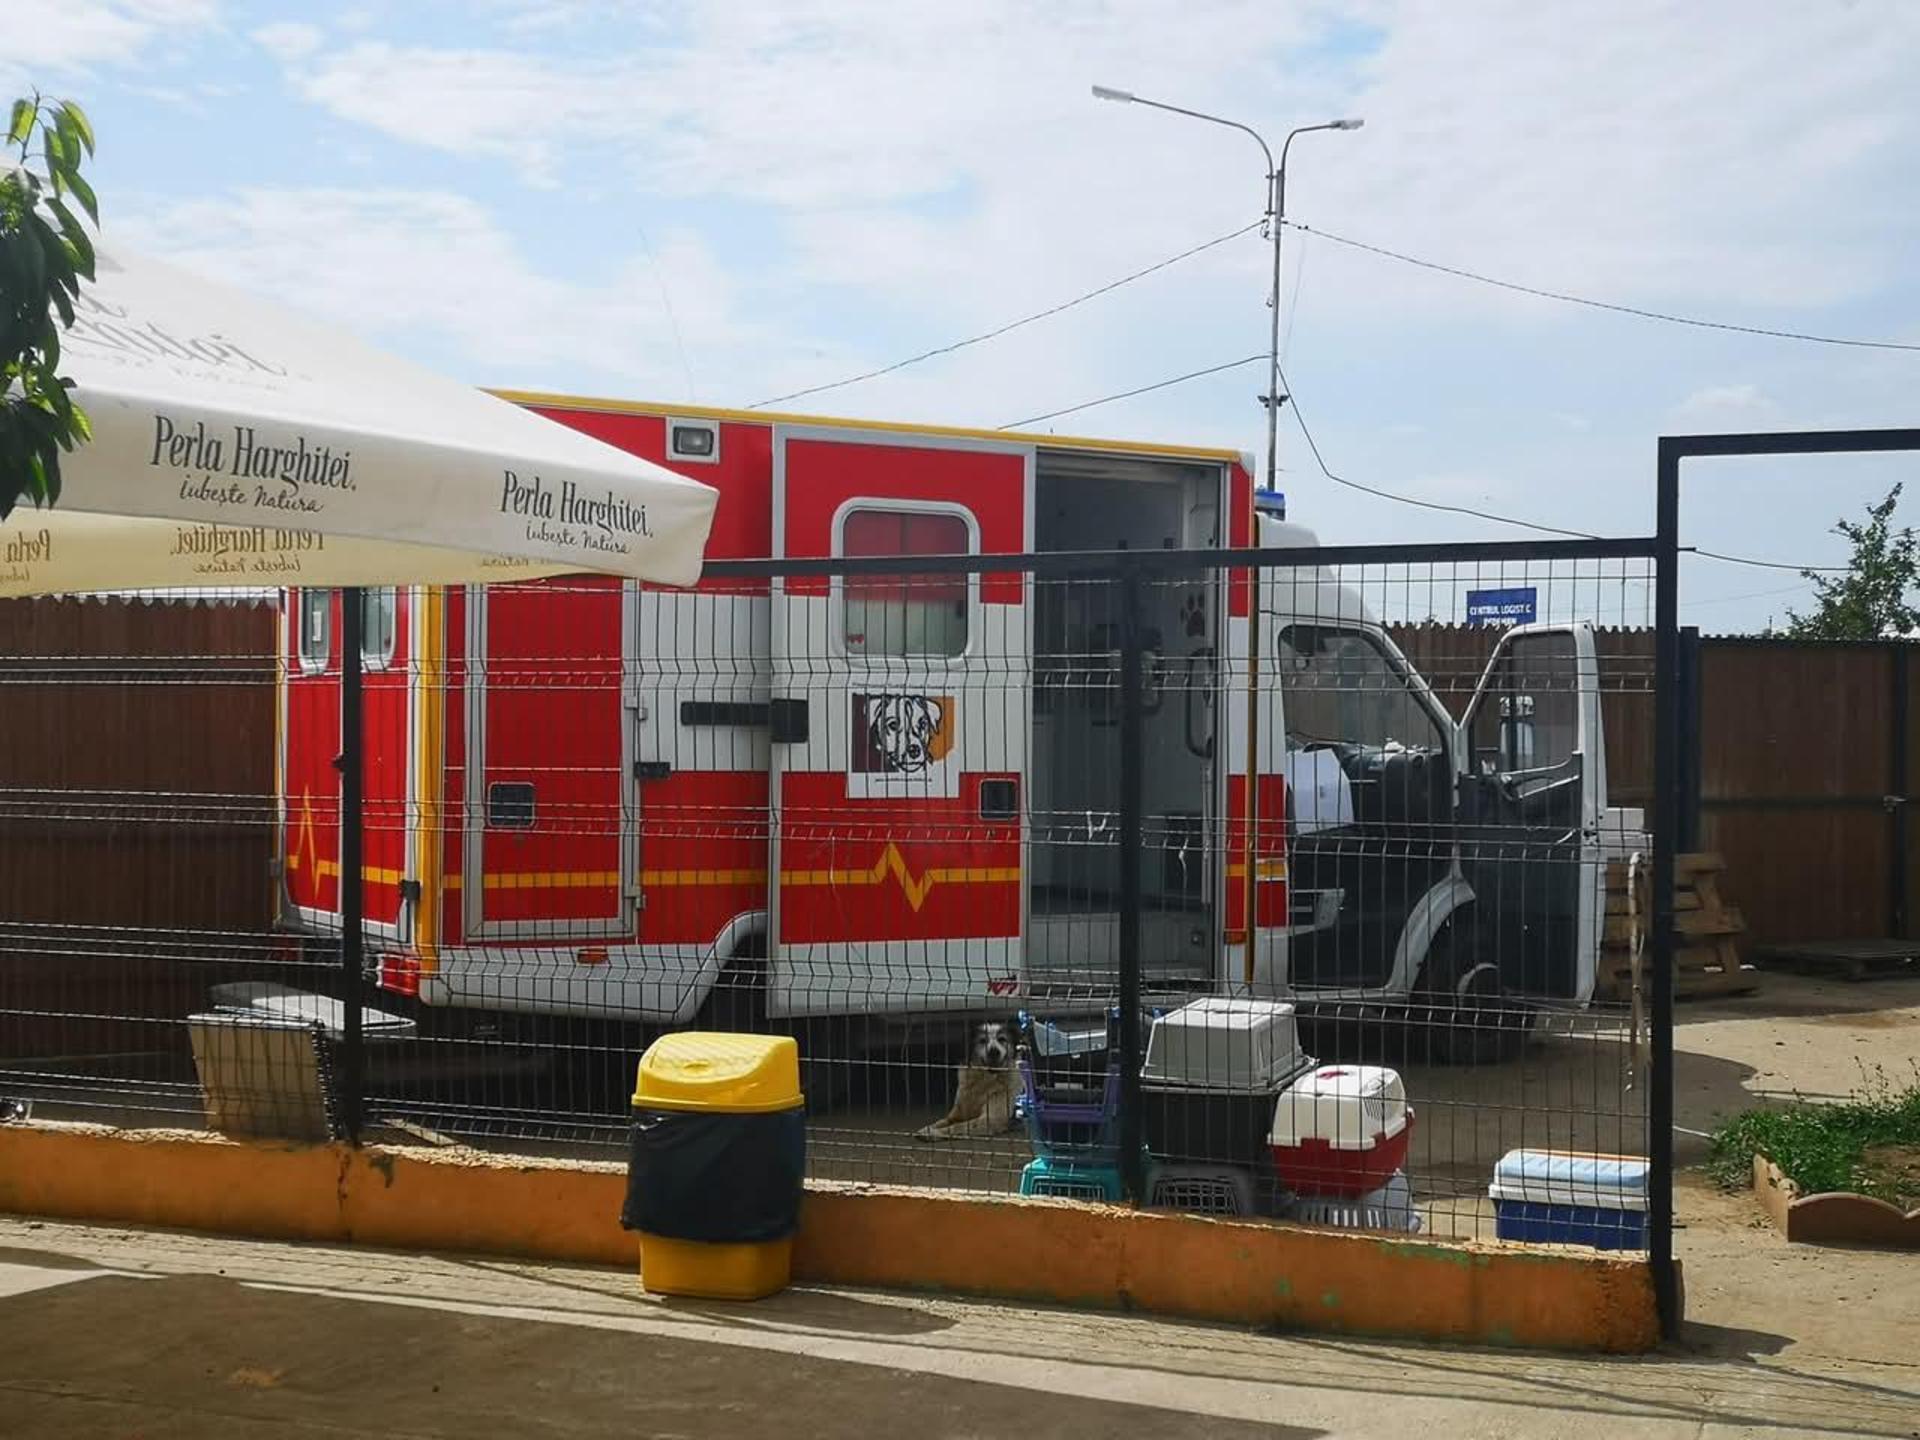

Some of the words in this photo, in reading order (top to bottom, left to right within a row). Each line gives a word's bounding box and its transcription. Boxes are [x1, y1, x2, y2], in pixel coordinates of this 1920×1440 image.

[150, 415, 225, 472] Perla
[501, 470, 555, 519] Perla
[1501, 603, 1532, 614] LOGISTC
